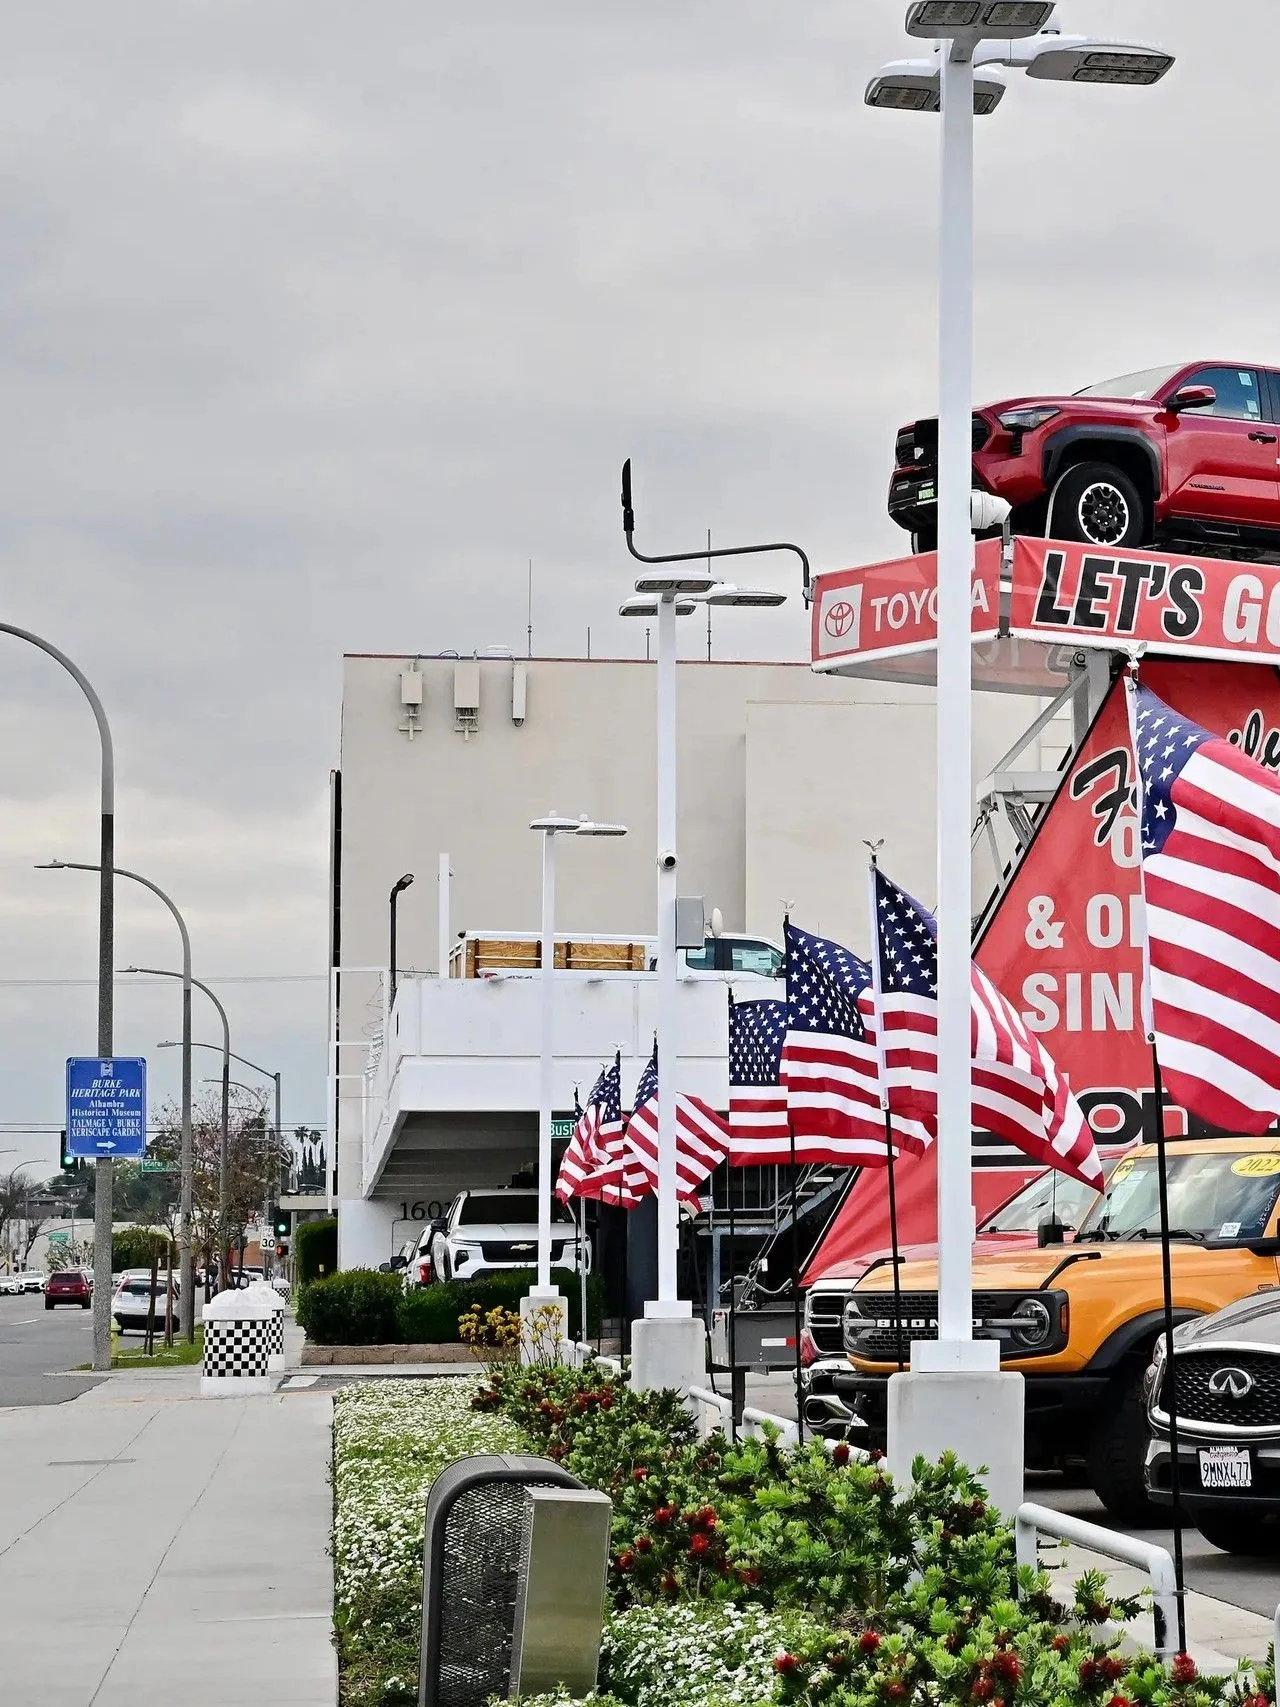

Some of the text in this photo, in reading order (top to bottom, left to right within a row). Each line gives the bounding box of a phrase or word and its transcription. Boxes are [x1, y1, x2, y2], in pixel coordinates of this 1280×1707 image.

[1031, 549, 1206, 641] LET'S
[870, 578, 990, 632] TOYA
[1024, 895, 1066, 950] &
[1021, 972, 1147, 1033] SIN
[92, 1080, 123, 1088] BURKE
[71, 1089, 142, 1098] HERITAGE PARK
[89, 1100, 125, 1108] Alhambra
[71, 1109, 141, 1117] Historical Museum
[72, 1119, 107, 1128] TALMAGE
[117, 1119, 141, 1128] BURKE
[71, 1128, 141, 1137] XERISCAPE GARDEN
[1238, 1158, 1280, 1172] 2022
[262, 1239, 275, 1248] 30
[877, 1319, 983, 1328] BRONO
[1203, 1461, 1249, 1481] 9MNX477
[1201, 1479, 1251, 1487] WONDRIES
